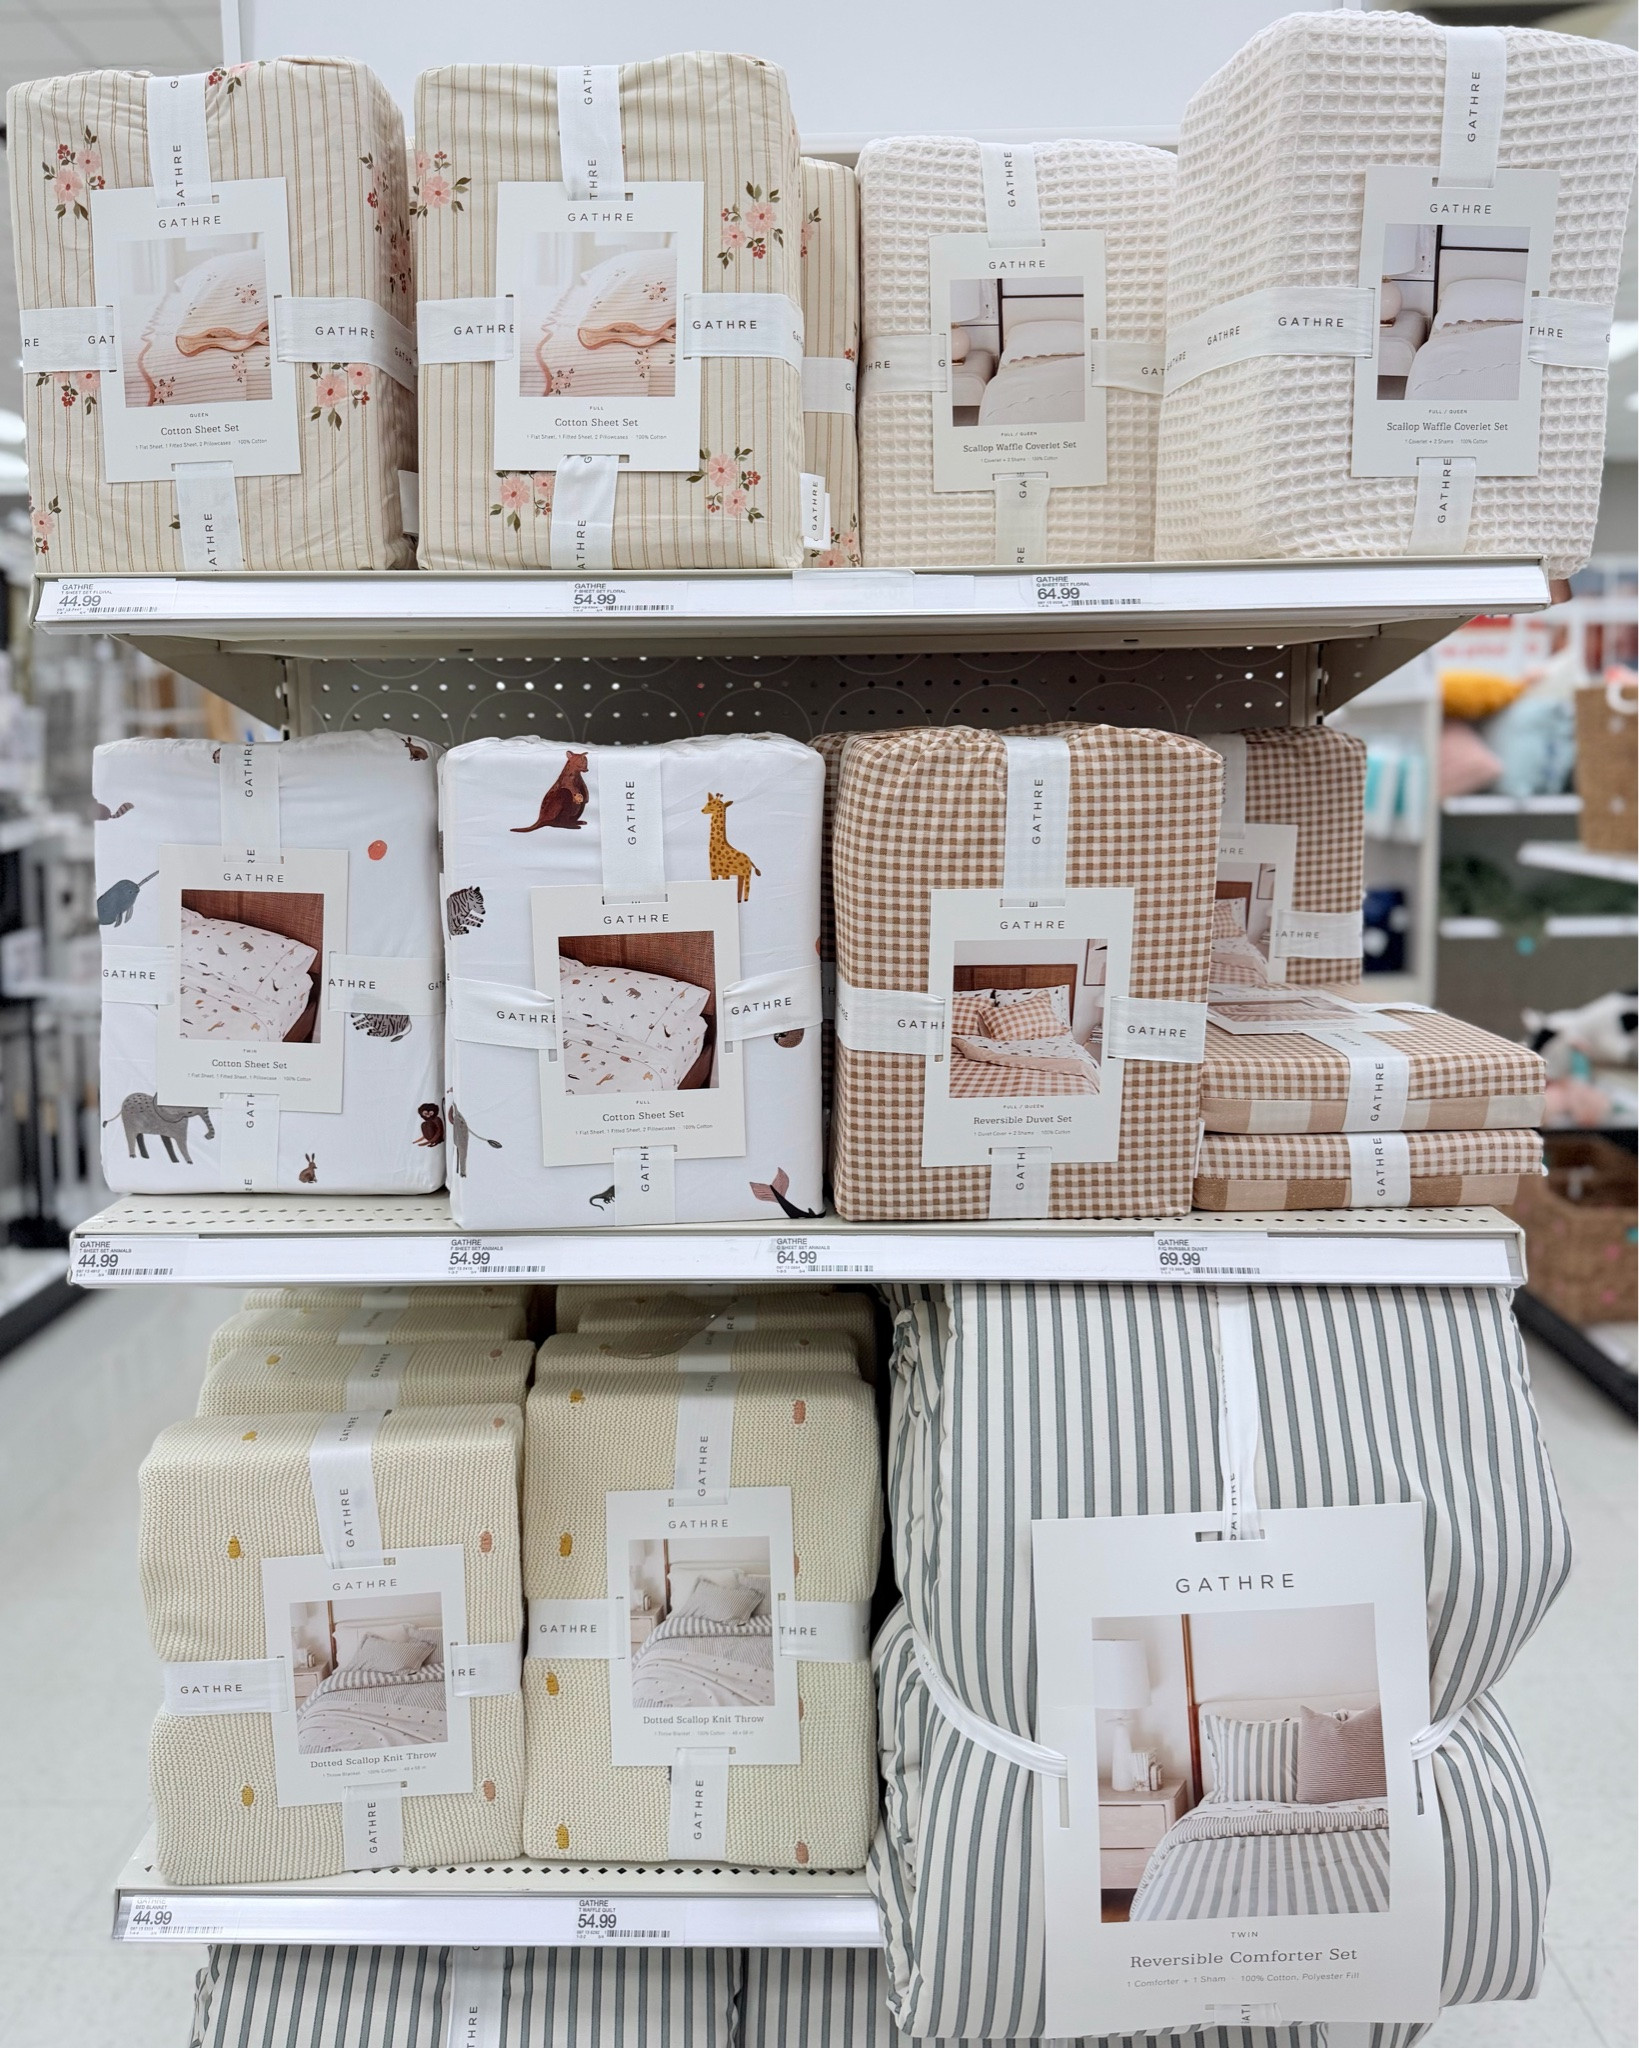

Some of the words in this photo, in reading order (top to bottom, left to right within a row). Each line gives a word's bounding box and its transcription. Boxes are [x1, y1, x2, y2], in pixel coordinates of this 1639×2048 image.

[1468, 71, 1481, 142] GATHRE
[1004, 152, 1016, 208] GATHRE
[1430, 203, 1492, 214] GATHRE
[158, 215, 221, 229] GATHRE
[567, 213, 634, 222] GATHRE
[988, 259, 1047, 270] GATHRE
[692, 320, 757, 330] GATHRE
[1278, 317, 1345, 328] GATHRE
[315, 326, 375, 339] GATHRE
[454, 324, 515, 335] GATHRE
[1207, 326, 1241, 346] GATHRE
[554, 418, 588, 427] Cotton
[591, 418, 619, 427] Sheet
[622, 418, 639, 427] Set
[1386, 422, 1420, 432] Scallop
[1422, 422, 1452, 431] Waffle
[1454, 422, 1491, 431] Coverlet
[1493, 422, 1508, 431] Set
[160, 427, 192, 436] Cotton
[194, 425, 221, 434] Sheet
[224, 424, 240, 432] Set
[963, 444, 994, 453] Scallop
[996, 443, 1023, 451] Waffle
[1025, 442, 1060, 451] Coverlet
[1062, 441, 1077, 449] Set
[1437, 457, 1452, 524] GATHRE
[203, 513, 223, 572] ATHRE
[62, 583, 94, 591] GATHRE
[1037, 587, 1080, 600] 64.99
[59, 595, 102, 607] 44.99
[574, 594, 617, 605] 54.99
[625, 780, 637, 845] GATHRE
[1032, 779, 1044, 845] GATHRE
[222, 872, 285, 883] GATHRE
[603, 913, 670, 925] GATHRE
[1000, 920, 1065, 930] GATHRE
[102, 970, 157, 980] GATHRE
[731, 997, 793, 1015] GATHRE
[1127, 1024, 1187, 1038] GATHRE
[211, 1059, 242, 1068] Cotton
[244, 1060, 270, 1069] Sheet
[272, 1061, 288, 1069] Set
[1370, 1062, 1384, 1122] GATHRE
[602, 1113, 636, 1122] Cotton
[638, 1112, 666, 1120] Sheet
[669, 1110, 685, 1119] Set
[973, 1115, 1023, 1125] Reversible
[1026, 1116, 1054, 1124] Duvet
[1057, 1115, 1072, 1123] Set
[1370, 1137, 1386, 1197] GATHRE
[78, 1254, 119, 1268] 44.99
[449, 1251, 491, 1265] 54.99
[777, 1251, 817, 1264] 64.99
[1159, 1252, 1201, 1266] 69.99
[697, 1435, 709, 1497] GATHRE
[339, 1488, 355, 1548] GATHRE
[668, 1519, 729, 1529] GATHRE
[332, 1577, 398, 1591] GATHRE
[1176, 1573, 1296, 1594] GATHRE
[539, 1624, 598, 1633] GATHRE
[180, 1683, 243, 1695] GATHRE
[643, 1716, 674, 1724] Dotted
[676, 1715, 710, 1725] Scallop
[712, 1715, 732, 1723] Knit
[734, 1715, 765, 1723] Throw
[310, 1759, 343, 1769] Dotted
[345, 1756, 380, 1766] Scallop
[383, 1753, 403, 1762] Knit
[406, 1751, 437, 1761] Throw
[694, 1779, 704, 1840] GATHRE
[367, 1801, 378, 1854] GATHRE
[132, 1910, 173, 1925] 44.99
[577, 1913, 617, 1929] 54.99
[1130, 1952, 1223, 1968] Reversible
[1230, 1950, 1322, 1964] Comforter
[1329, 1948, 1358, 1961] Set
[1134, 1978, 1179, 1987] Comforter
[1200, 1975, 1226, 1983] Sham
[1240, 1974, 1264, 1982] 100%
[1267, 1973, 1299, 1982] Cotton,
[1301, 1972, 1343, 1982] Polyester
